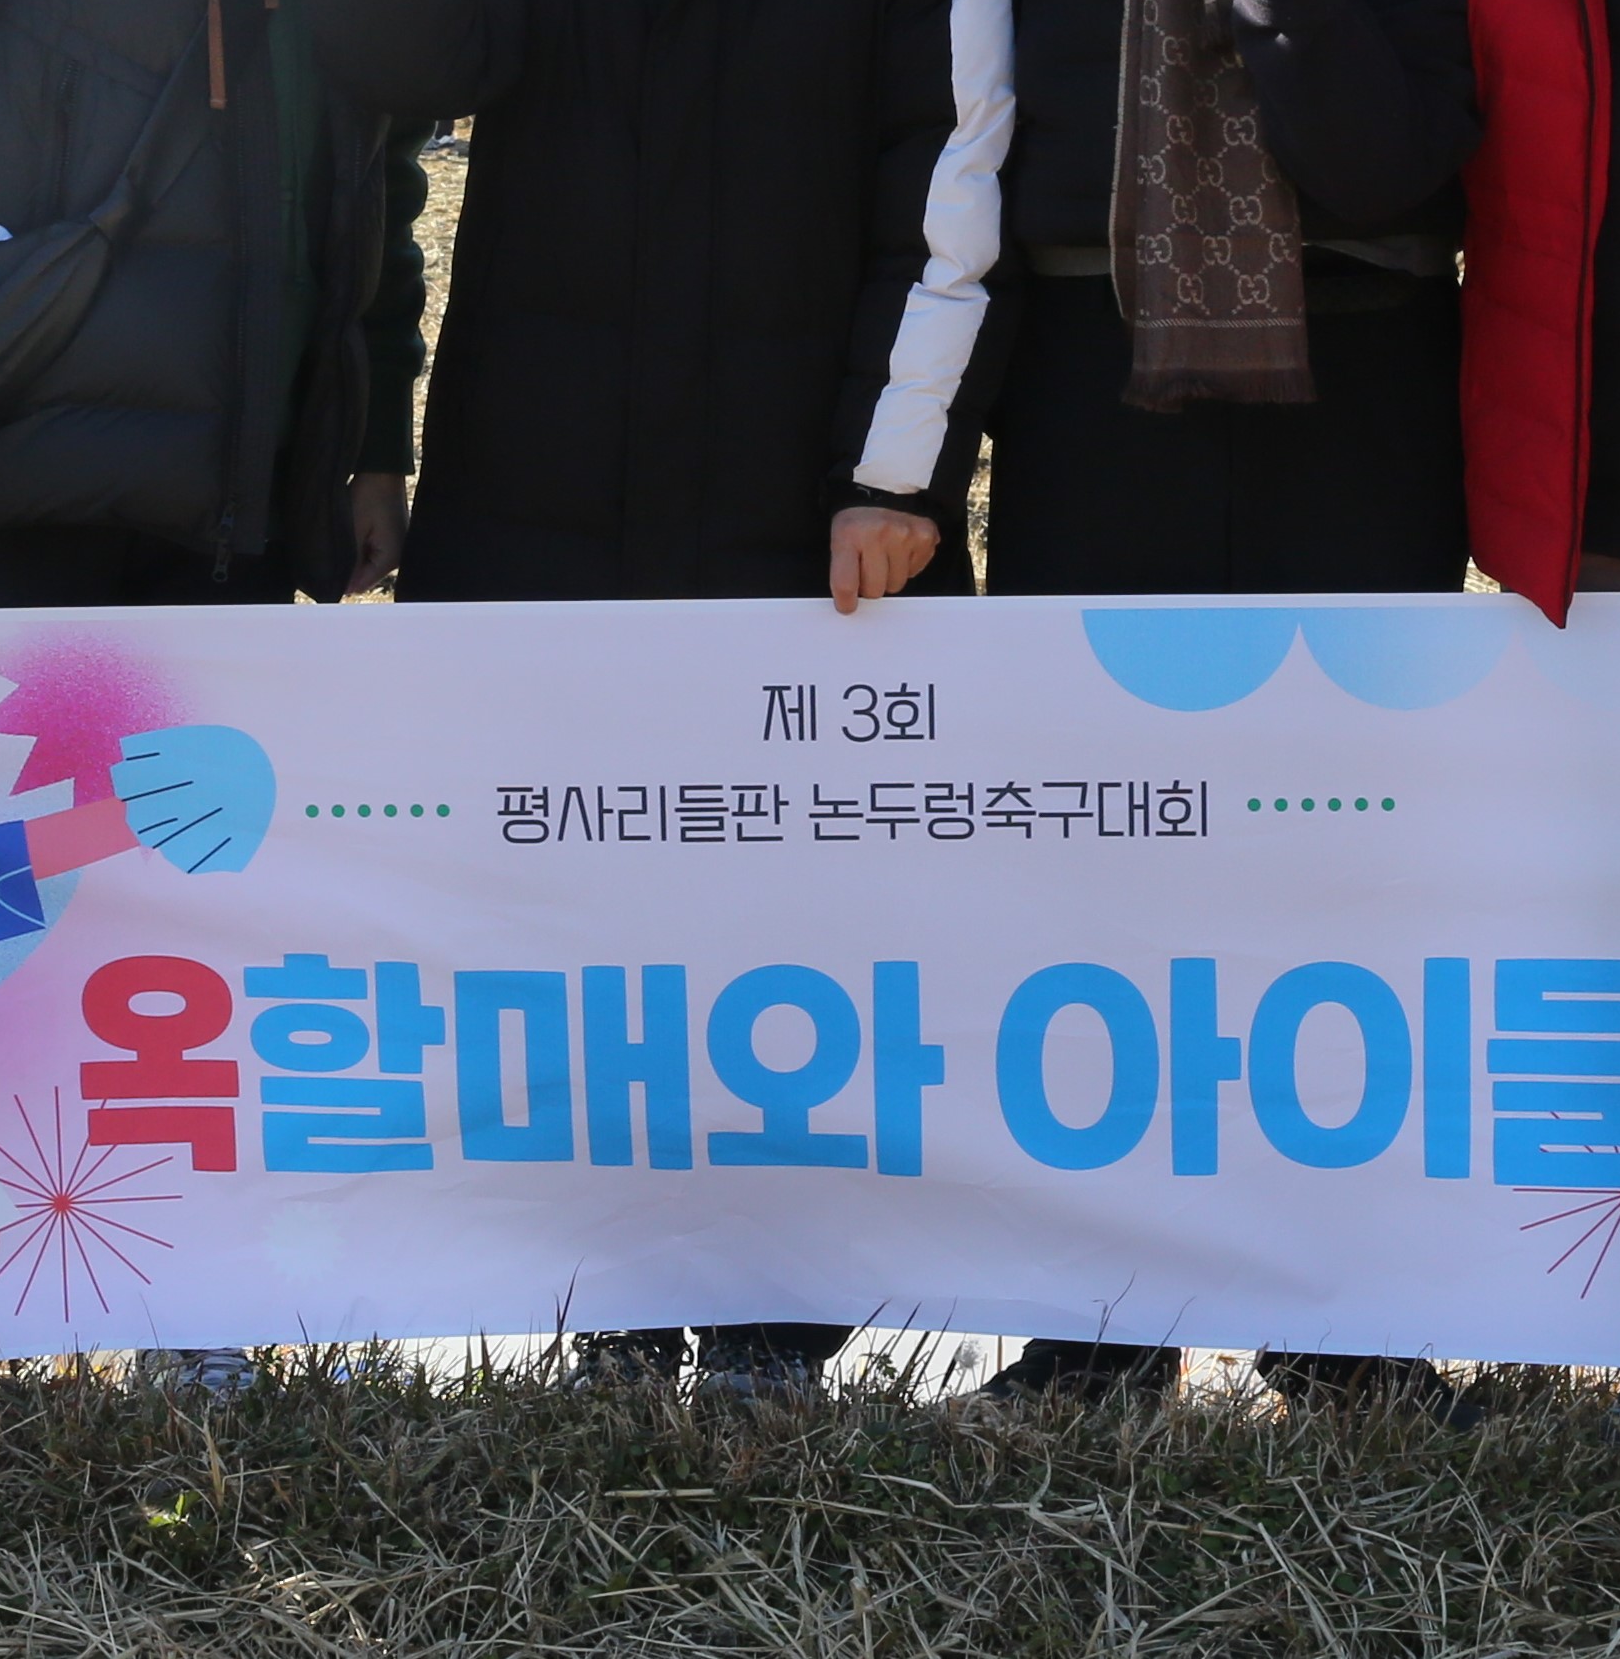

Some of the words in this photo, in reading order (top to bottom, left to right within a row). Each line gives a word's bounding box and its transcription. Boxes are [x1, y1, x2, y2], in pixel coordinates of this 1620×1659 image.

[762, 683, 817, 742] 제
[841, 682, 937, 743] 3회
[495, 783, 790, 845] 평사리들판
[808, 779, 1209, 843] 논두렁축구대회
[79, 951, 946, 1176] 옥할매와
